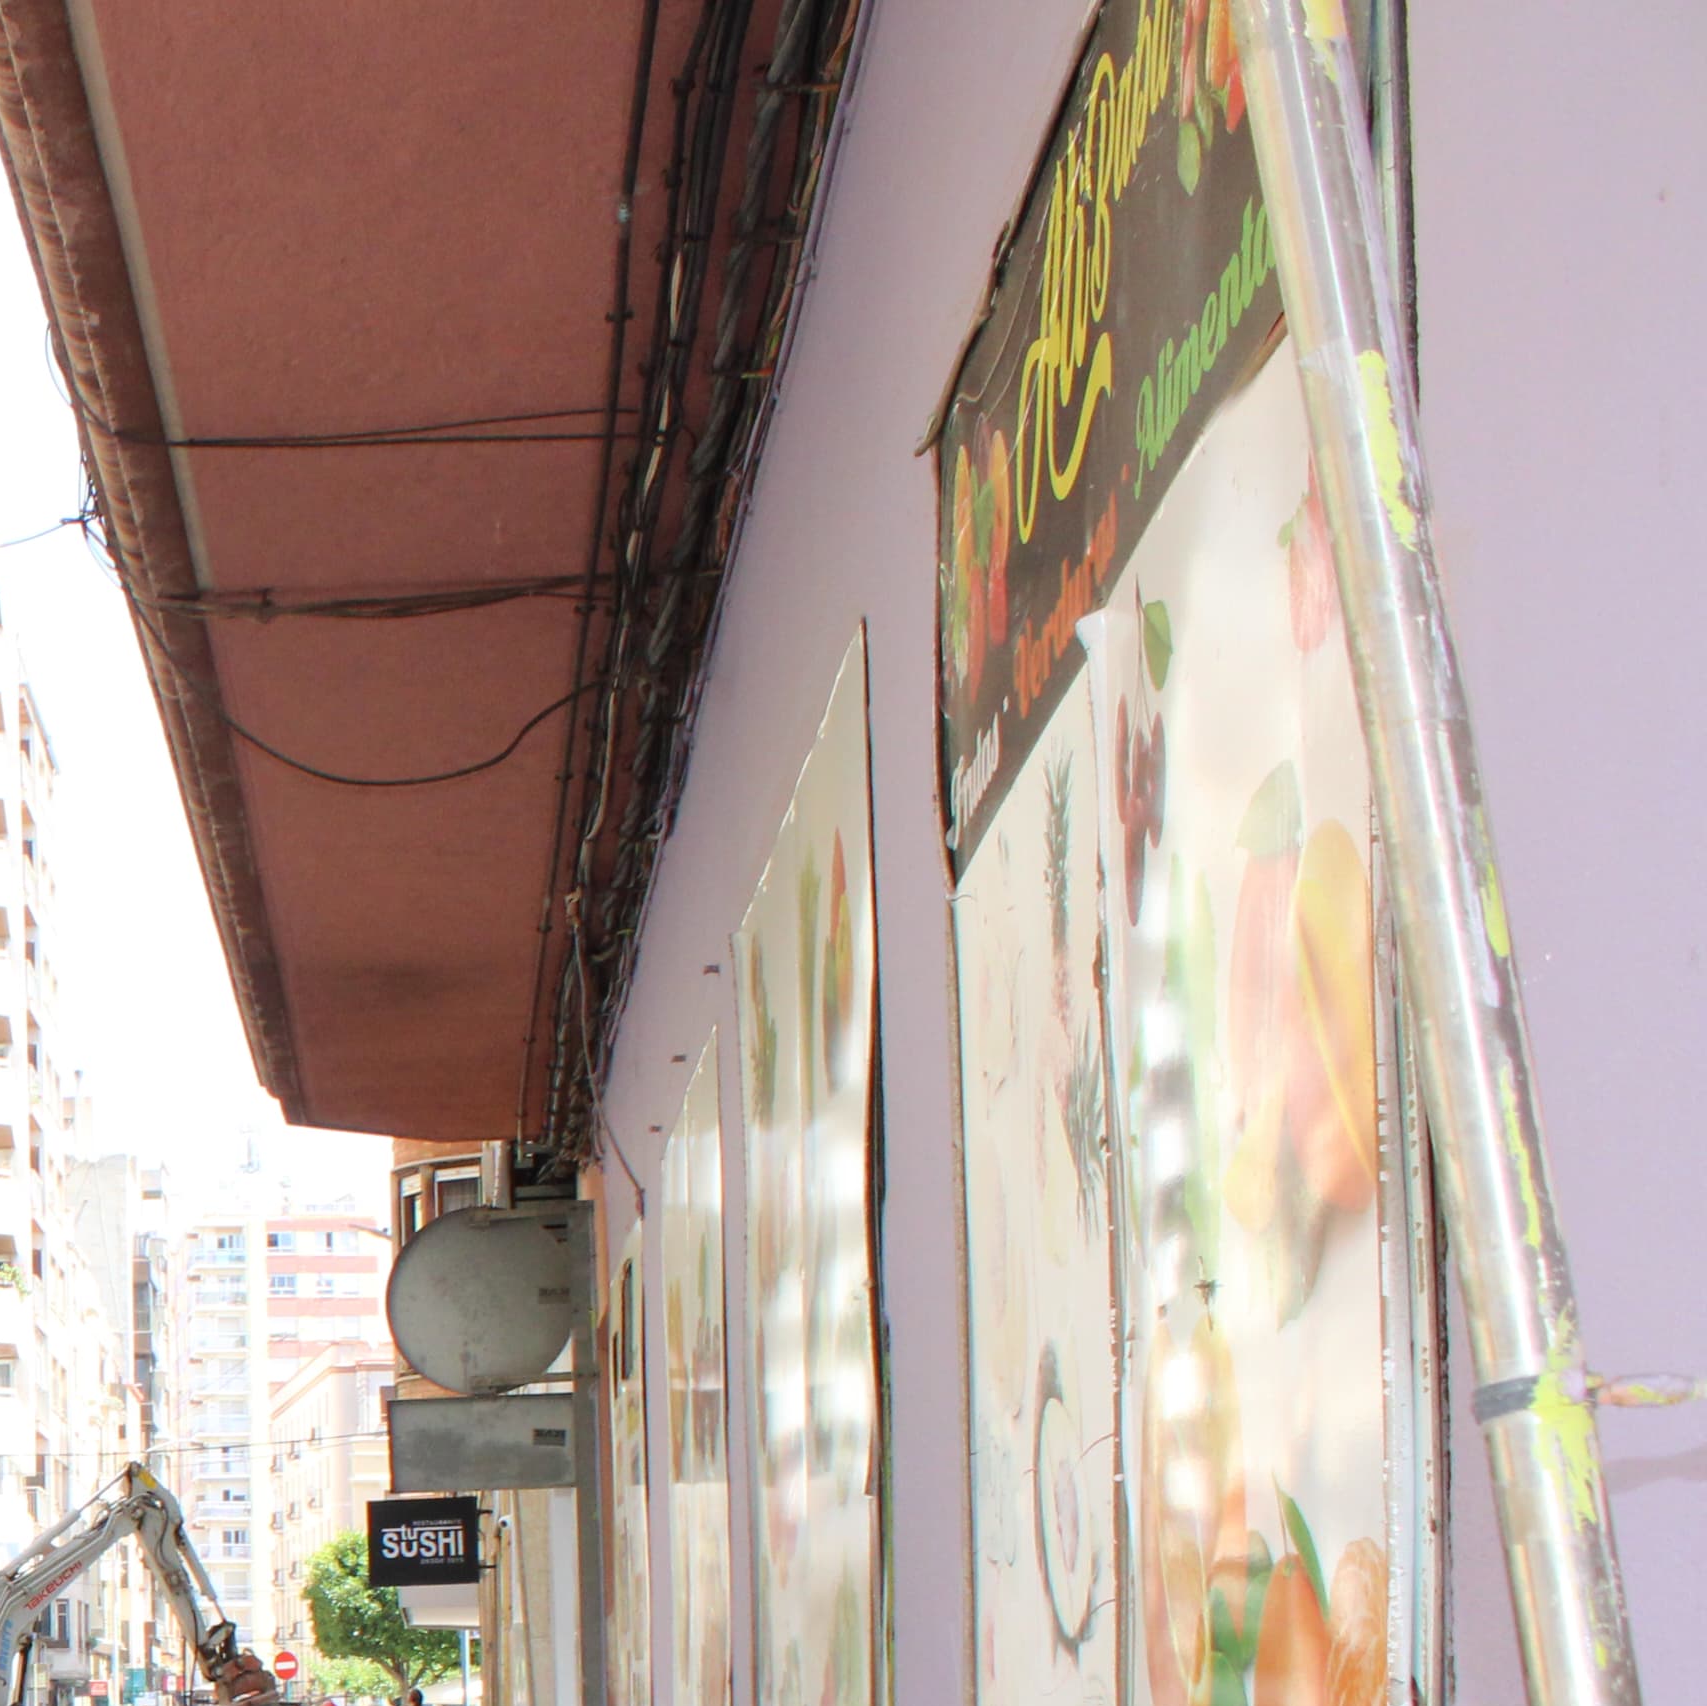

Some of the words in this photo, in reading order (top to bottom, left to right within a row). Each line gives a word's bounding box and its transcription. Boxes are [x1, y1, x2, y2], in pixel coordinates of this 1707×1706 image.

[952, 712, 1000, 850] Frutas
[1014, 490, 1118, 719] Verduras
[1136, 196, 1277, 500] Alimenta
[381, 1530, 464, 1559] SUSHI
